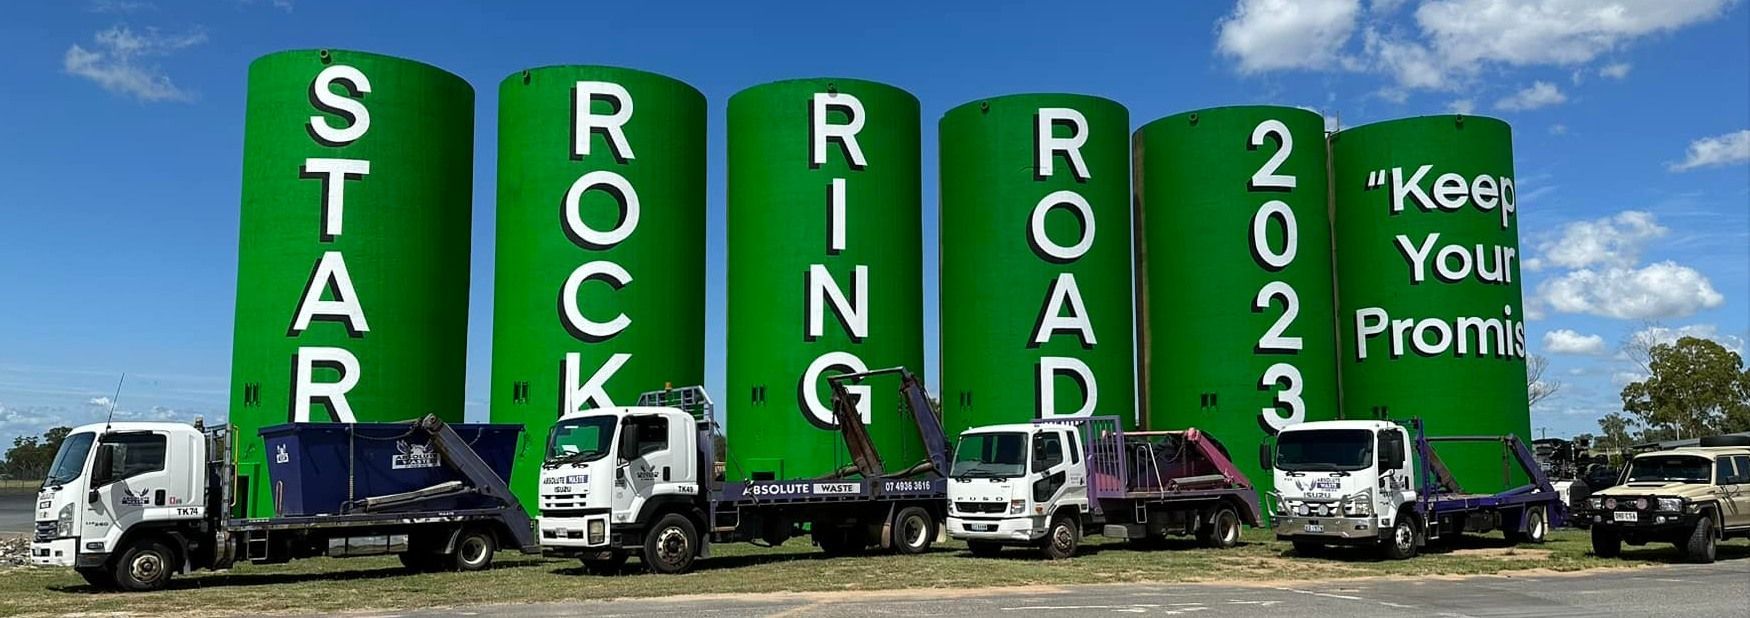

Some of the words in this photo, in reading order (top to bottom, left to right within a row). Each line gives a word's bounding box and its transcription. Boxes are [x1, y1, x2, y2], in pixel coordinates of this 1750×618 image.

[290, 63, 372, 423] STAR
[562, 80, 640, 415] ROCK
[802, 91, 872, 428] RING
[1030, 107, 1097, 420] ROAD
[1250, 119, 1306, 434] 2023
[1396, 231, 1516, 285] Your
[743, 483, 809, 495] ABSOLUTE
[885, 482, 894, 492] 07
